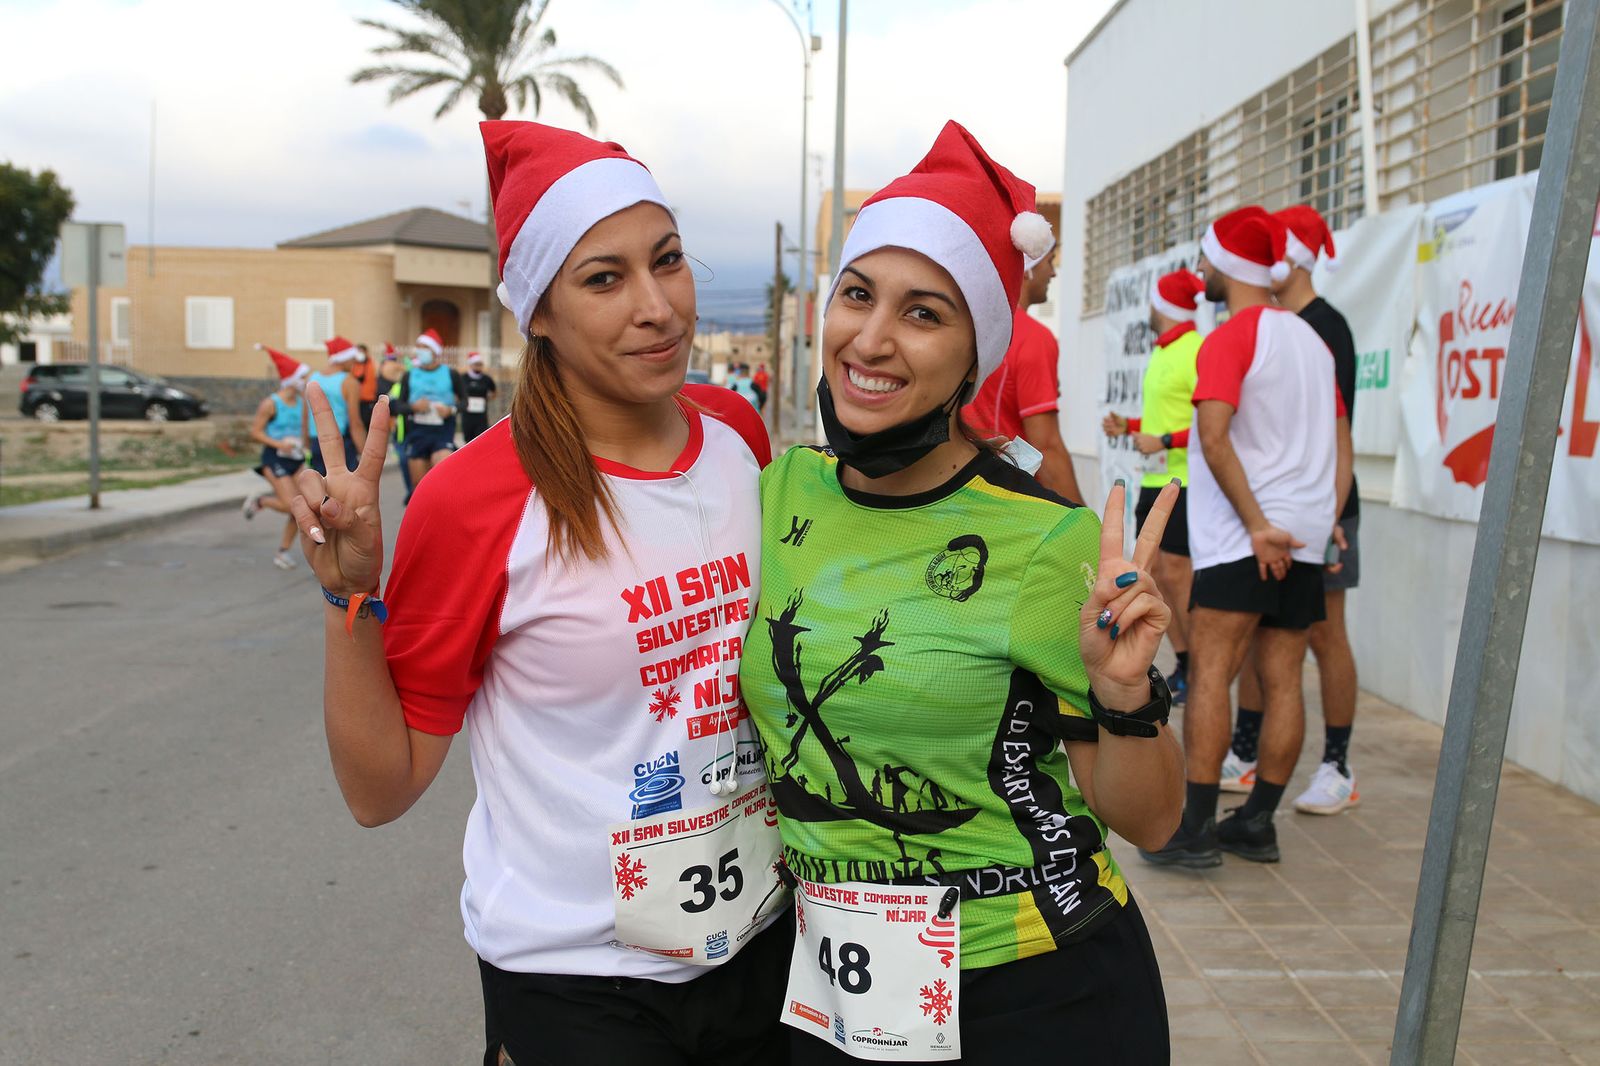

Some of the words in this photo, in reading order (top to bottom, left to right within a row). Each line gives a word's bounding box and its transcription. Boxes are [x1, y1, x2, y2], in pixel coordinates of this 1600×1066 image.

[621, 575, 672, 623] XII
[676, 552, 751, 607] SAN
[636, 598, 750, 654] SILVESTRE
[694, 669, 740, 710] NÍJ
[634, 750, 679, 777] CUCN
[612, 830, 630, 846] XII
[634, 823, 664, 842] SAN
[667, 804, 730, 836] SILVESTRE
[678, 847, 744, 914] 35
[805, 882, 859, 906] SILVESTRE
[863, 892, 911, 905] COMARCA
[915, 895, 928, 905] DE
[706, 929, 727, 942] CUCN
[886, 907, 927, 923] NÍJAR
[818, 936, 872, 994] 48
